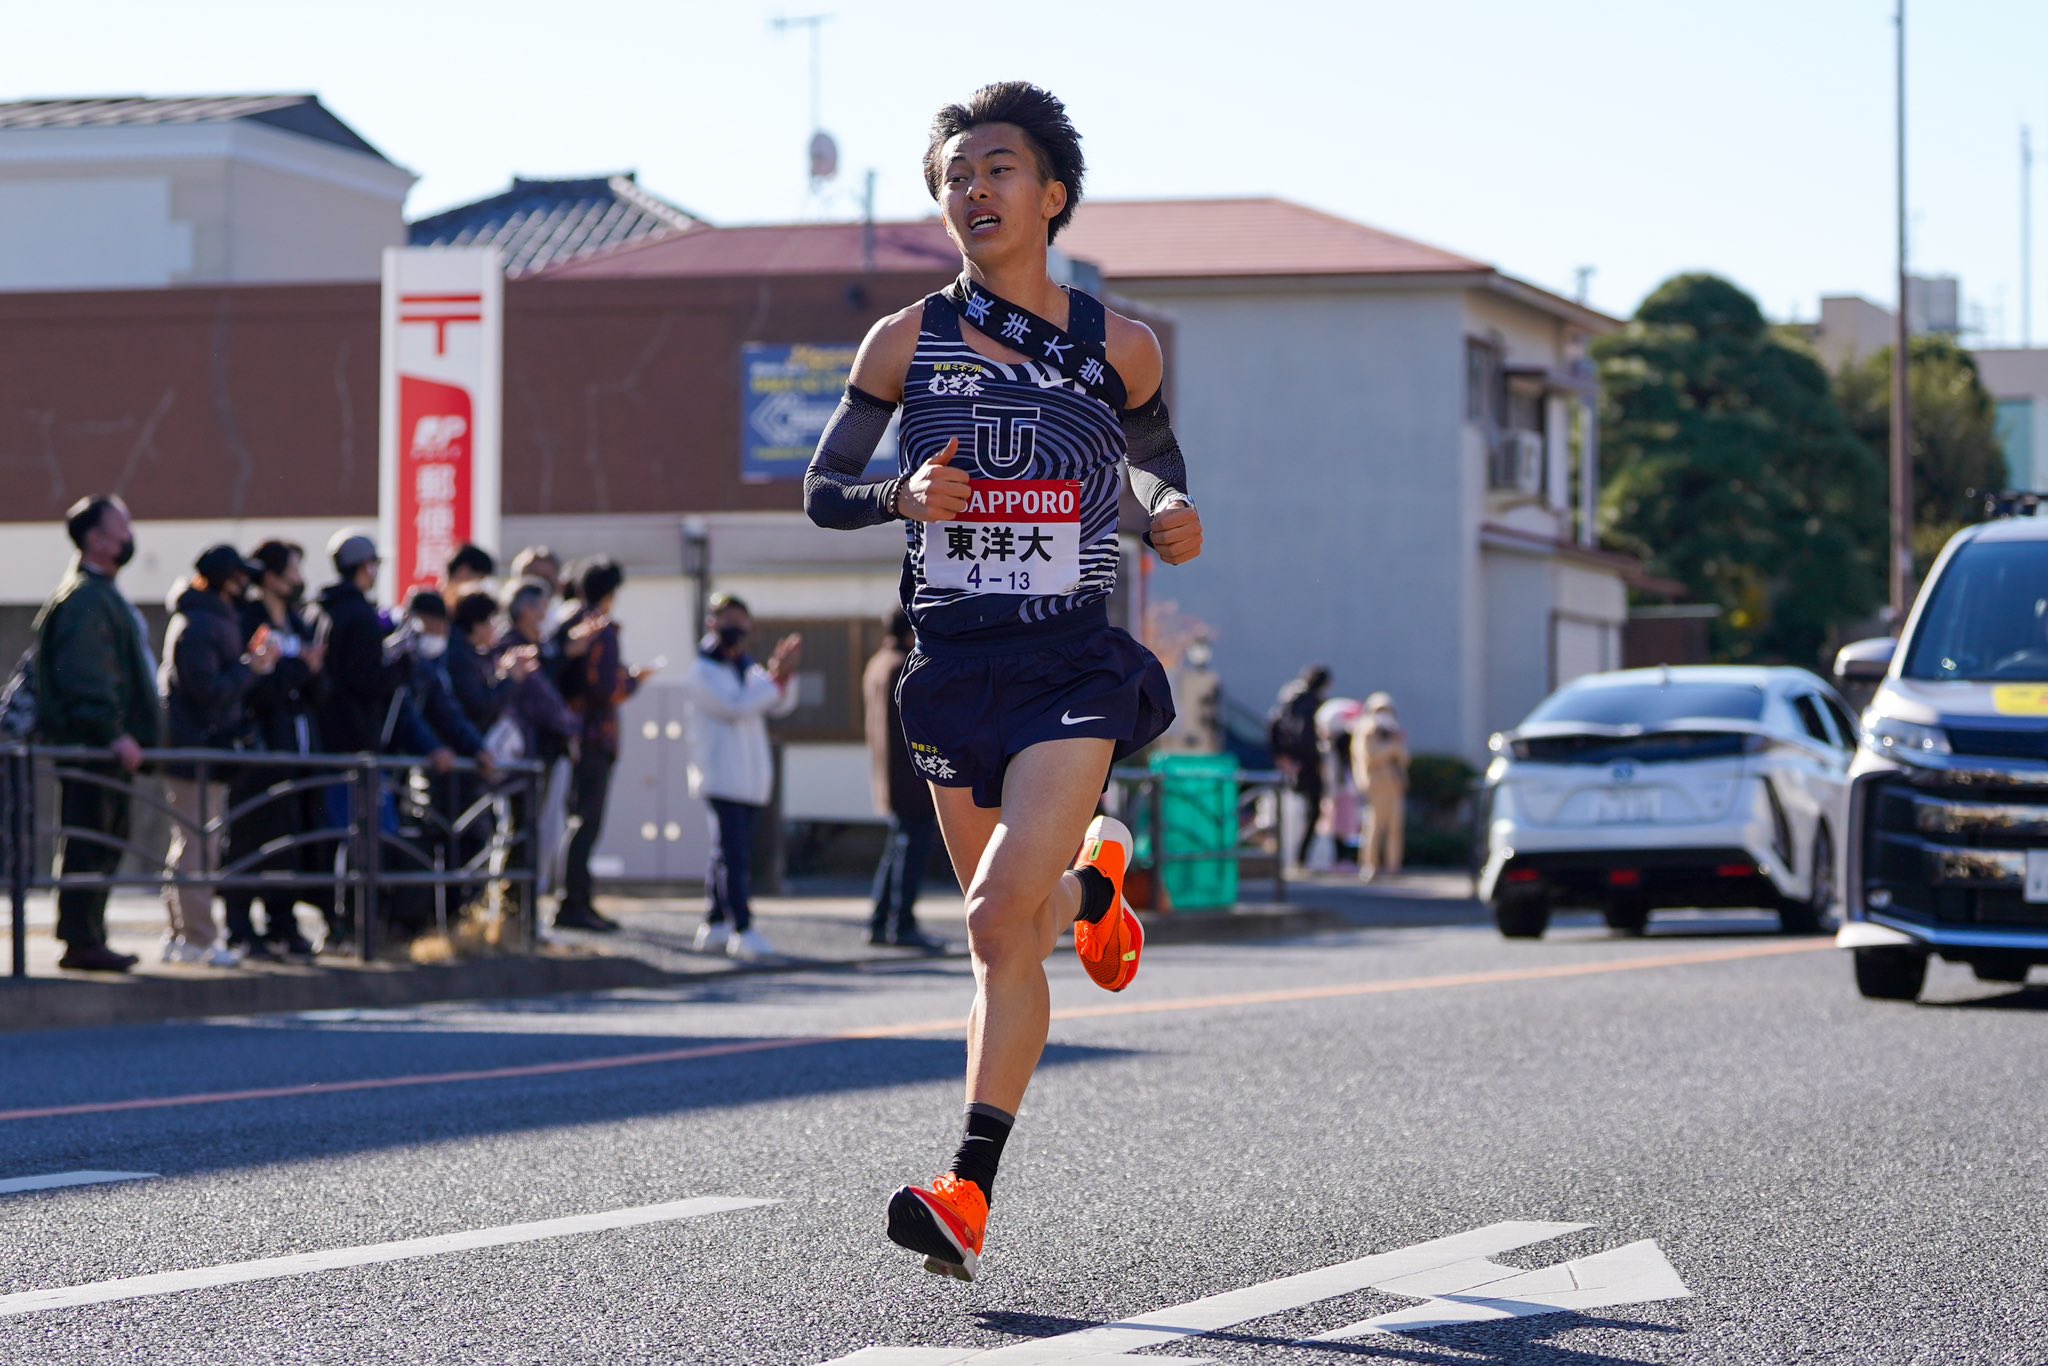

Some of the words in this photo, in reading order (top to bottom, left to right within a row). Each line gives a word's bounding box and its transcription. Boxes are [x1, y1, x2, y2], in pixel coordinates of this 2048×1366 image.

[965, 291, 1104, 386] 東洋大学
[928, 372, 985, 397] むぎ茶
[944, 524, 1054, 563] 東洋大
[966, 562, 1031, 590] 4-13
[913, 751, 957, 779] むぎ茶
